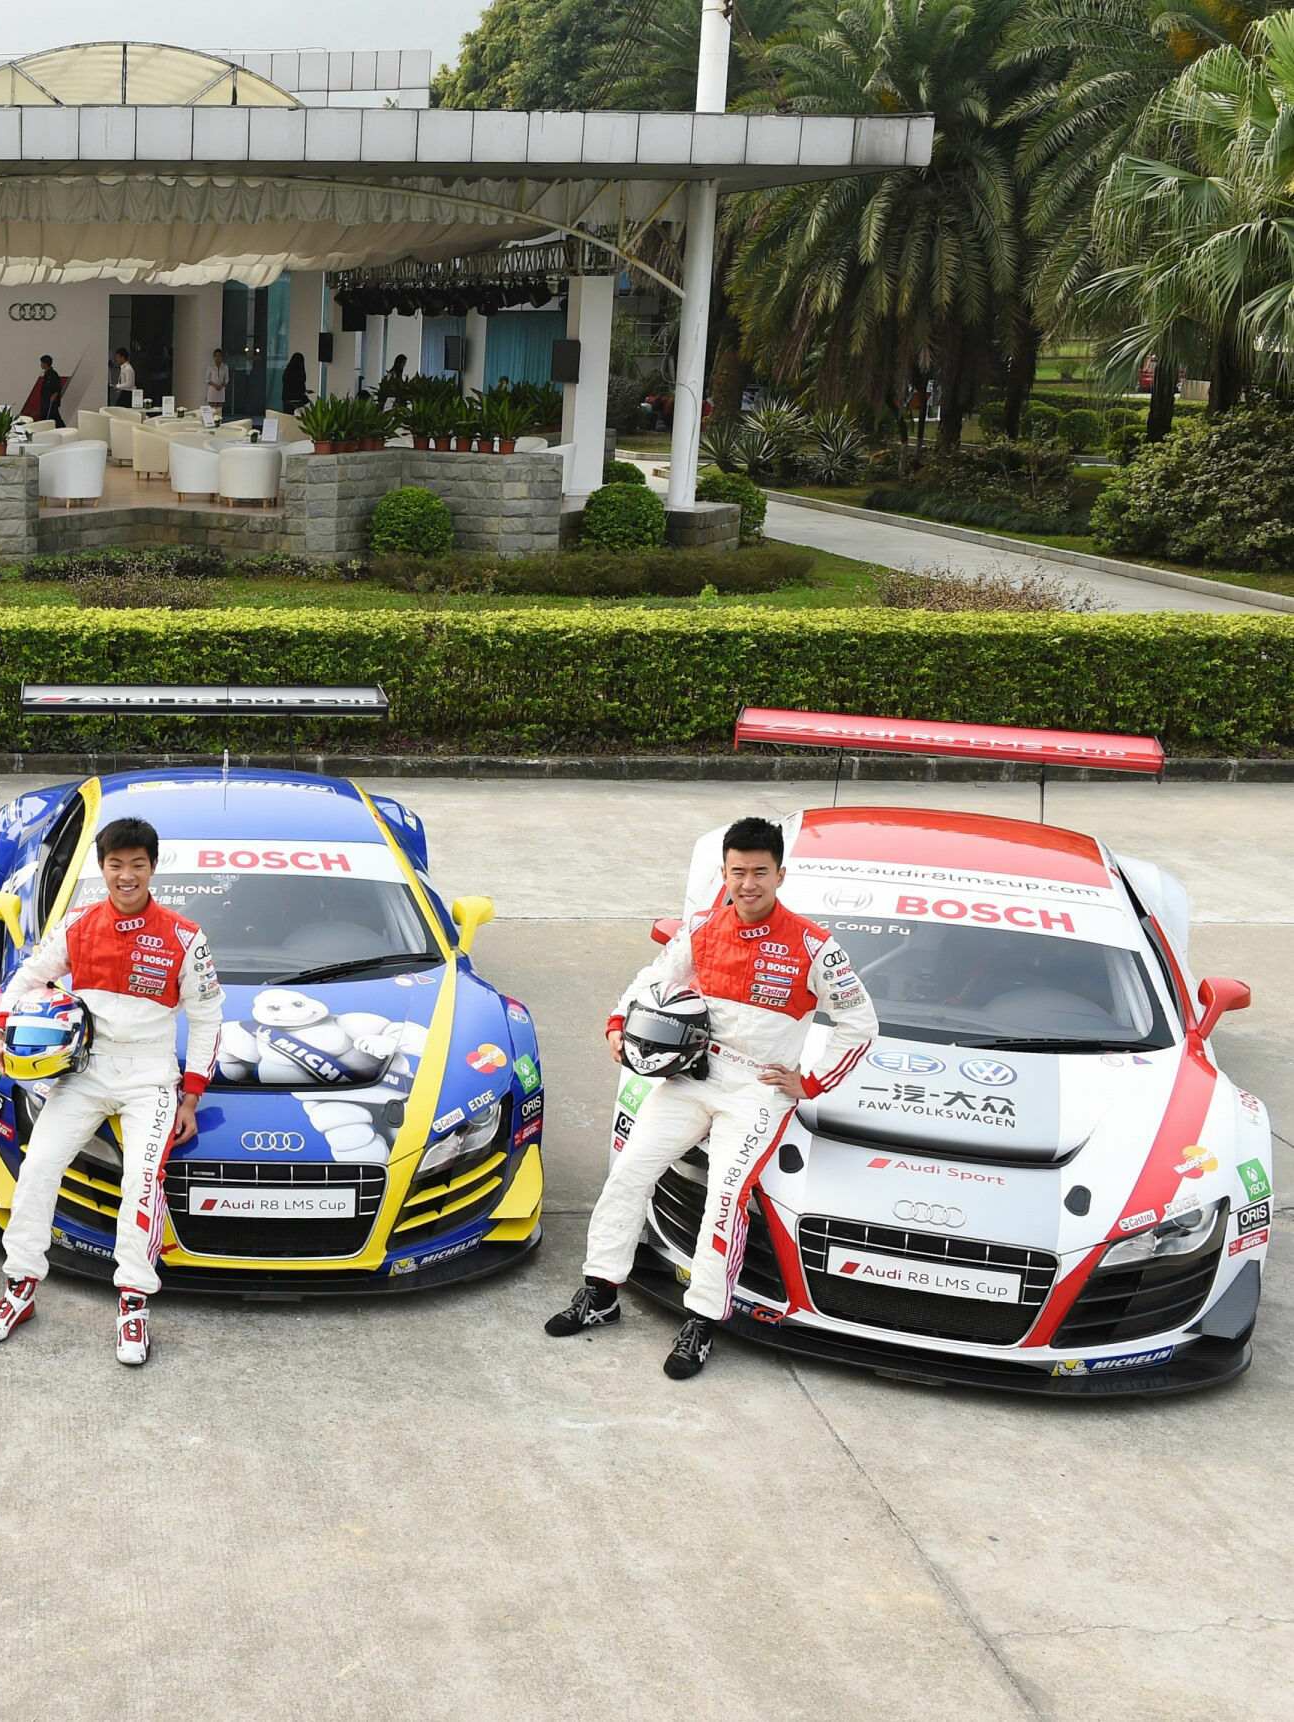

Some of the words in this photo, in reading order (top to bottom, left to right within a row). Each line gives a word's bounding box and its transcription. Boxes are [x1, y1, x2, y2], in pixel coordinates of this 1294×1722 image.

[198, 850, 351, 872] BOSCH
[162, 885, 223, 895] THONG
[798, 862, 1101, 898] www.audir8lmscup.com
[895, 894, 1076, 933] BOSCH
[835, 920, 883, 935] Cong
[888, 923, 911, 936] Fu
[143, 954, 174, 968] BOSCH
[767, 962, 799, 975] BOSCH
[128, 985, 164, 997] EDGE
[138, 977, 164, 989] Castrol
[760, 985, 788, 998] Castrol
[749, 994, 788, 1008] EDGE
[722, 1048, 745, 1064] CongFu
[747, 1059, 766, 1072] Cheng
[523, 1072, 538, 1088] XBOX
[467, 1089, 496, 1113] EDGE
[521, 1096, 542, 1117] ORIS
[621, 1090, 639, 1109] XBOX
[860, 1083, 1016, 1117] 一汽-大众
[152, 1110, 168, 1139] LMS
[441, 1110, 463, 1129] Castrol
[858, 1099, 1016, 1129] FAW-VOLKSWAGEN
[144, 1142, 159, 1165] R8
[715, 1190, 733, 1232] Audi
[724, 1166, 742, 1187] R8
[735, 1134, 759, 1165] LMS
[754, 1107, 771, 1134] Cup
[894, 1160, 941, 1175] Audi
[947, 1167, 1006, 1186] Sport
[139, 1167, 154, 1208] Audi
[1248, 1180, 1267, 1197] XBOX
[220, 1199, 255, 1211] Audi
[260, 1199, 279, 1211] R8
[284, 1199, 314, 1211] LMS
[319, 1199, 346, 1213] Cup
[1240, 1205, 1268, 1226] ORIS
[1128, 1212, 1155, 1228] Castrol
[75, 1241, 115, 1259] MICH
[421, 1236, 480, 1264] MICHELIN
[862, 1264, 901, 1281] Audi
[908, 1271, 930, 1285] R8
[935, 1276, 970, 1291] LMS
[976, 1282, 1008, 1298] Cup
[1092, 1349, 1171, 1370] MICHELIN
